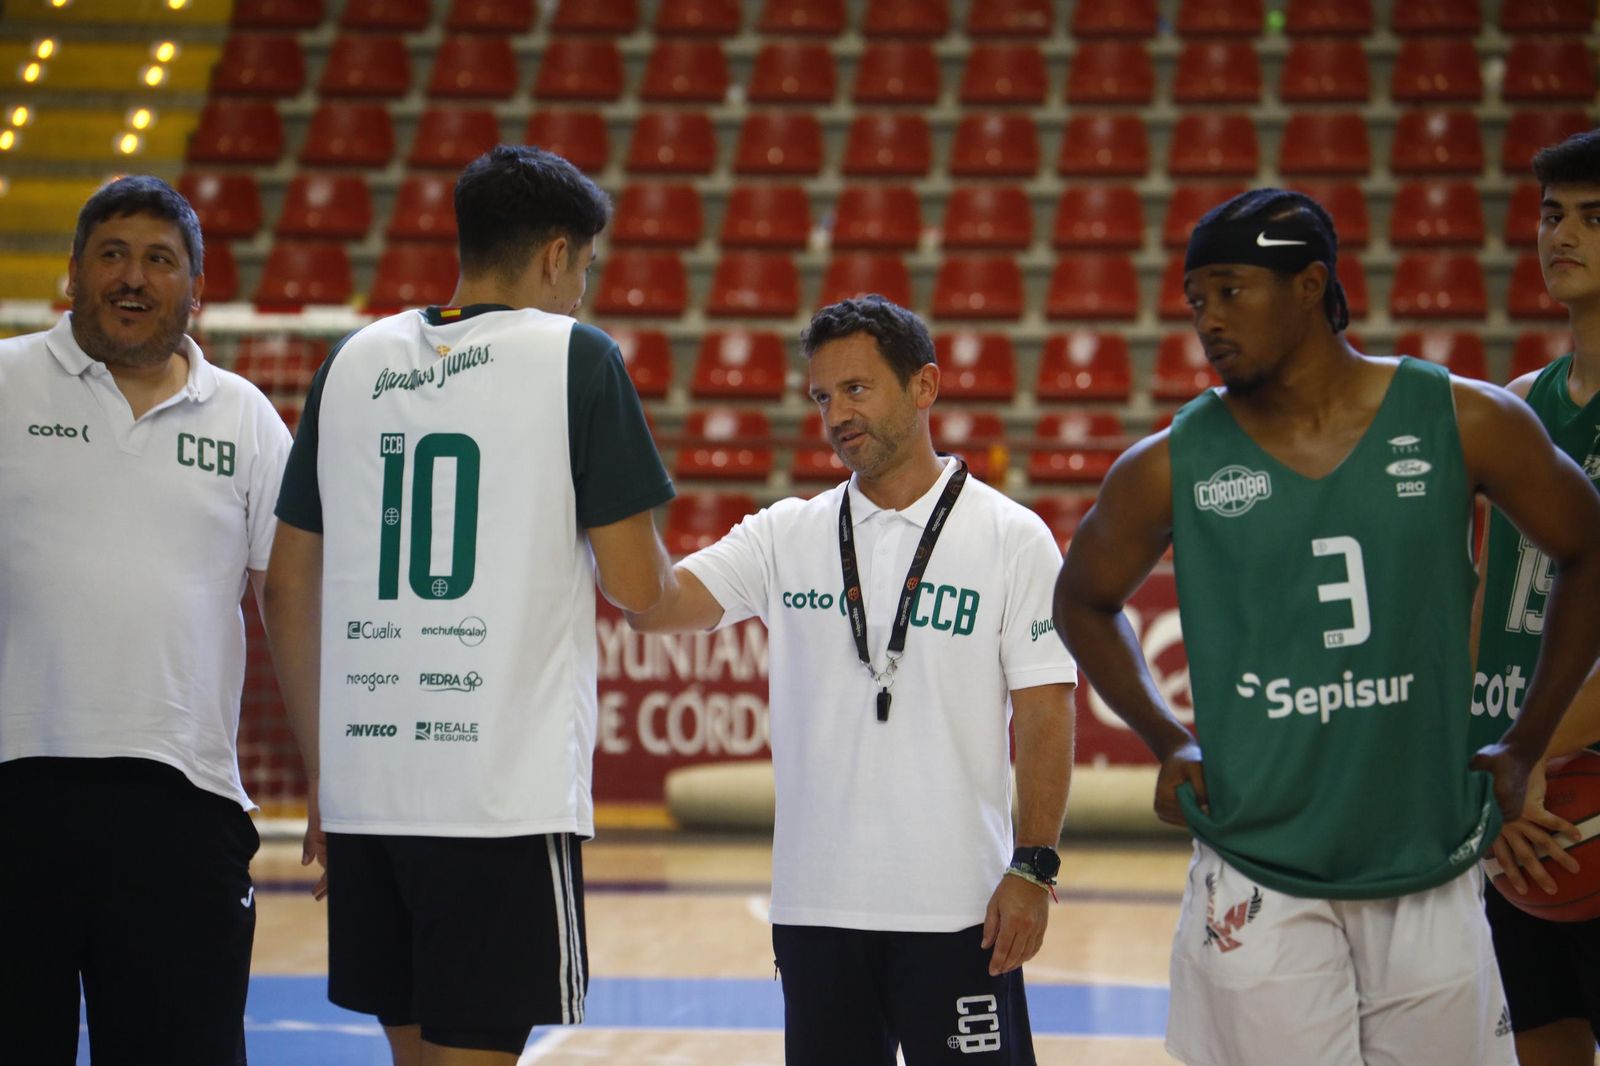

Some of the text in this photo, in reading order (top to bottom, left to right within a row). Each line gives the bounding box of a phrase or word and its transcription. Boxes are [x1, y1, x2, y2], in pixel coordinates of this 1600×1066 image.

[28, 423, 78, 438] coto
[177, 432, 236, 477] CCB
[382, 435, 403, 455] CCB
[1396, 481, 1425, 493] PRO
[378, 432, 481, 601] 10
[783, 589, 834, 610] coto
[1311, 535, 1372, 649] 3
[909, 581, 981, 637] CCB
[361, 621, 402, 639] Cualix
[421, 626, 486, 637] enchufesolar
[1326, 632, 1345, 646] CCB
[419, 673, 461, 686] PIEDRA
[1265, 670, 1415, 724] Sepisur
[434, 722, 479, 733] REALE
[637, 684, 770, 756] CÓRD
[345, 723, 398, 738] PINVECO
[433, 733, 479, 742] SEGUROS
[956, 994, 1001, 1054] CCB
